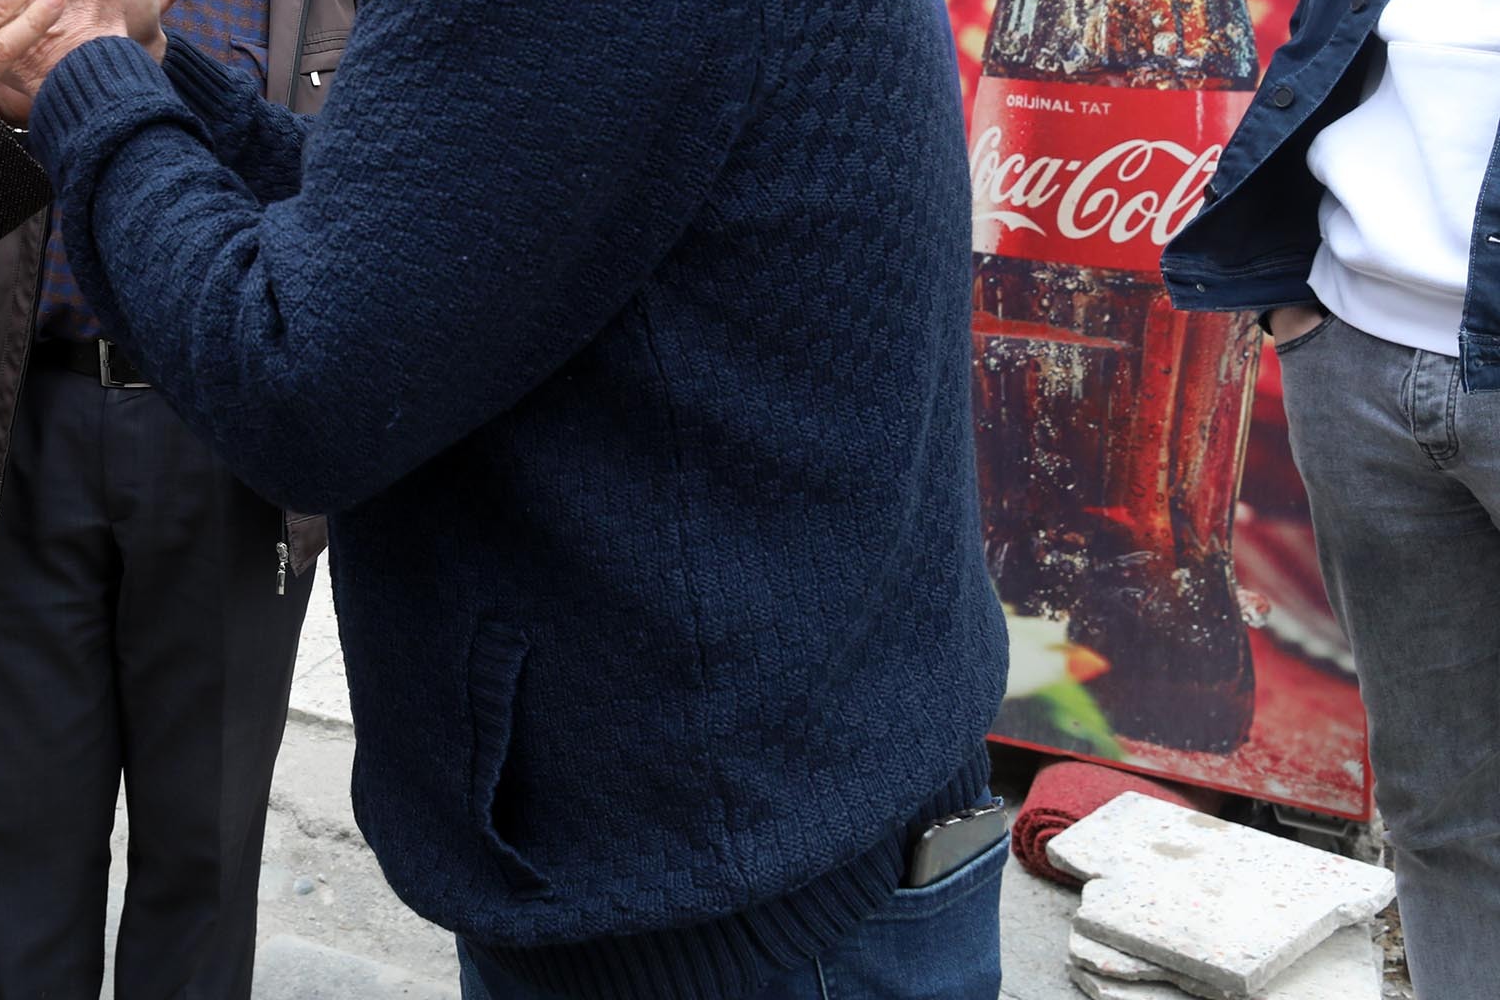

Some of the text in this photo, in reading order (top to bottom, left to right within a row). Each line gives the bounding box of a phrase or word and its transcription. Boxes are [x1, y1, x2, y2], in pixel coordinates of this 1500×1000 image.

[1006, 93, 1112, 116] ORİJİNAL TAT
[971, 126, 1223, 246] Coca-Col
